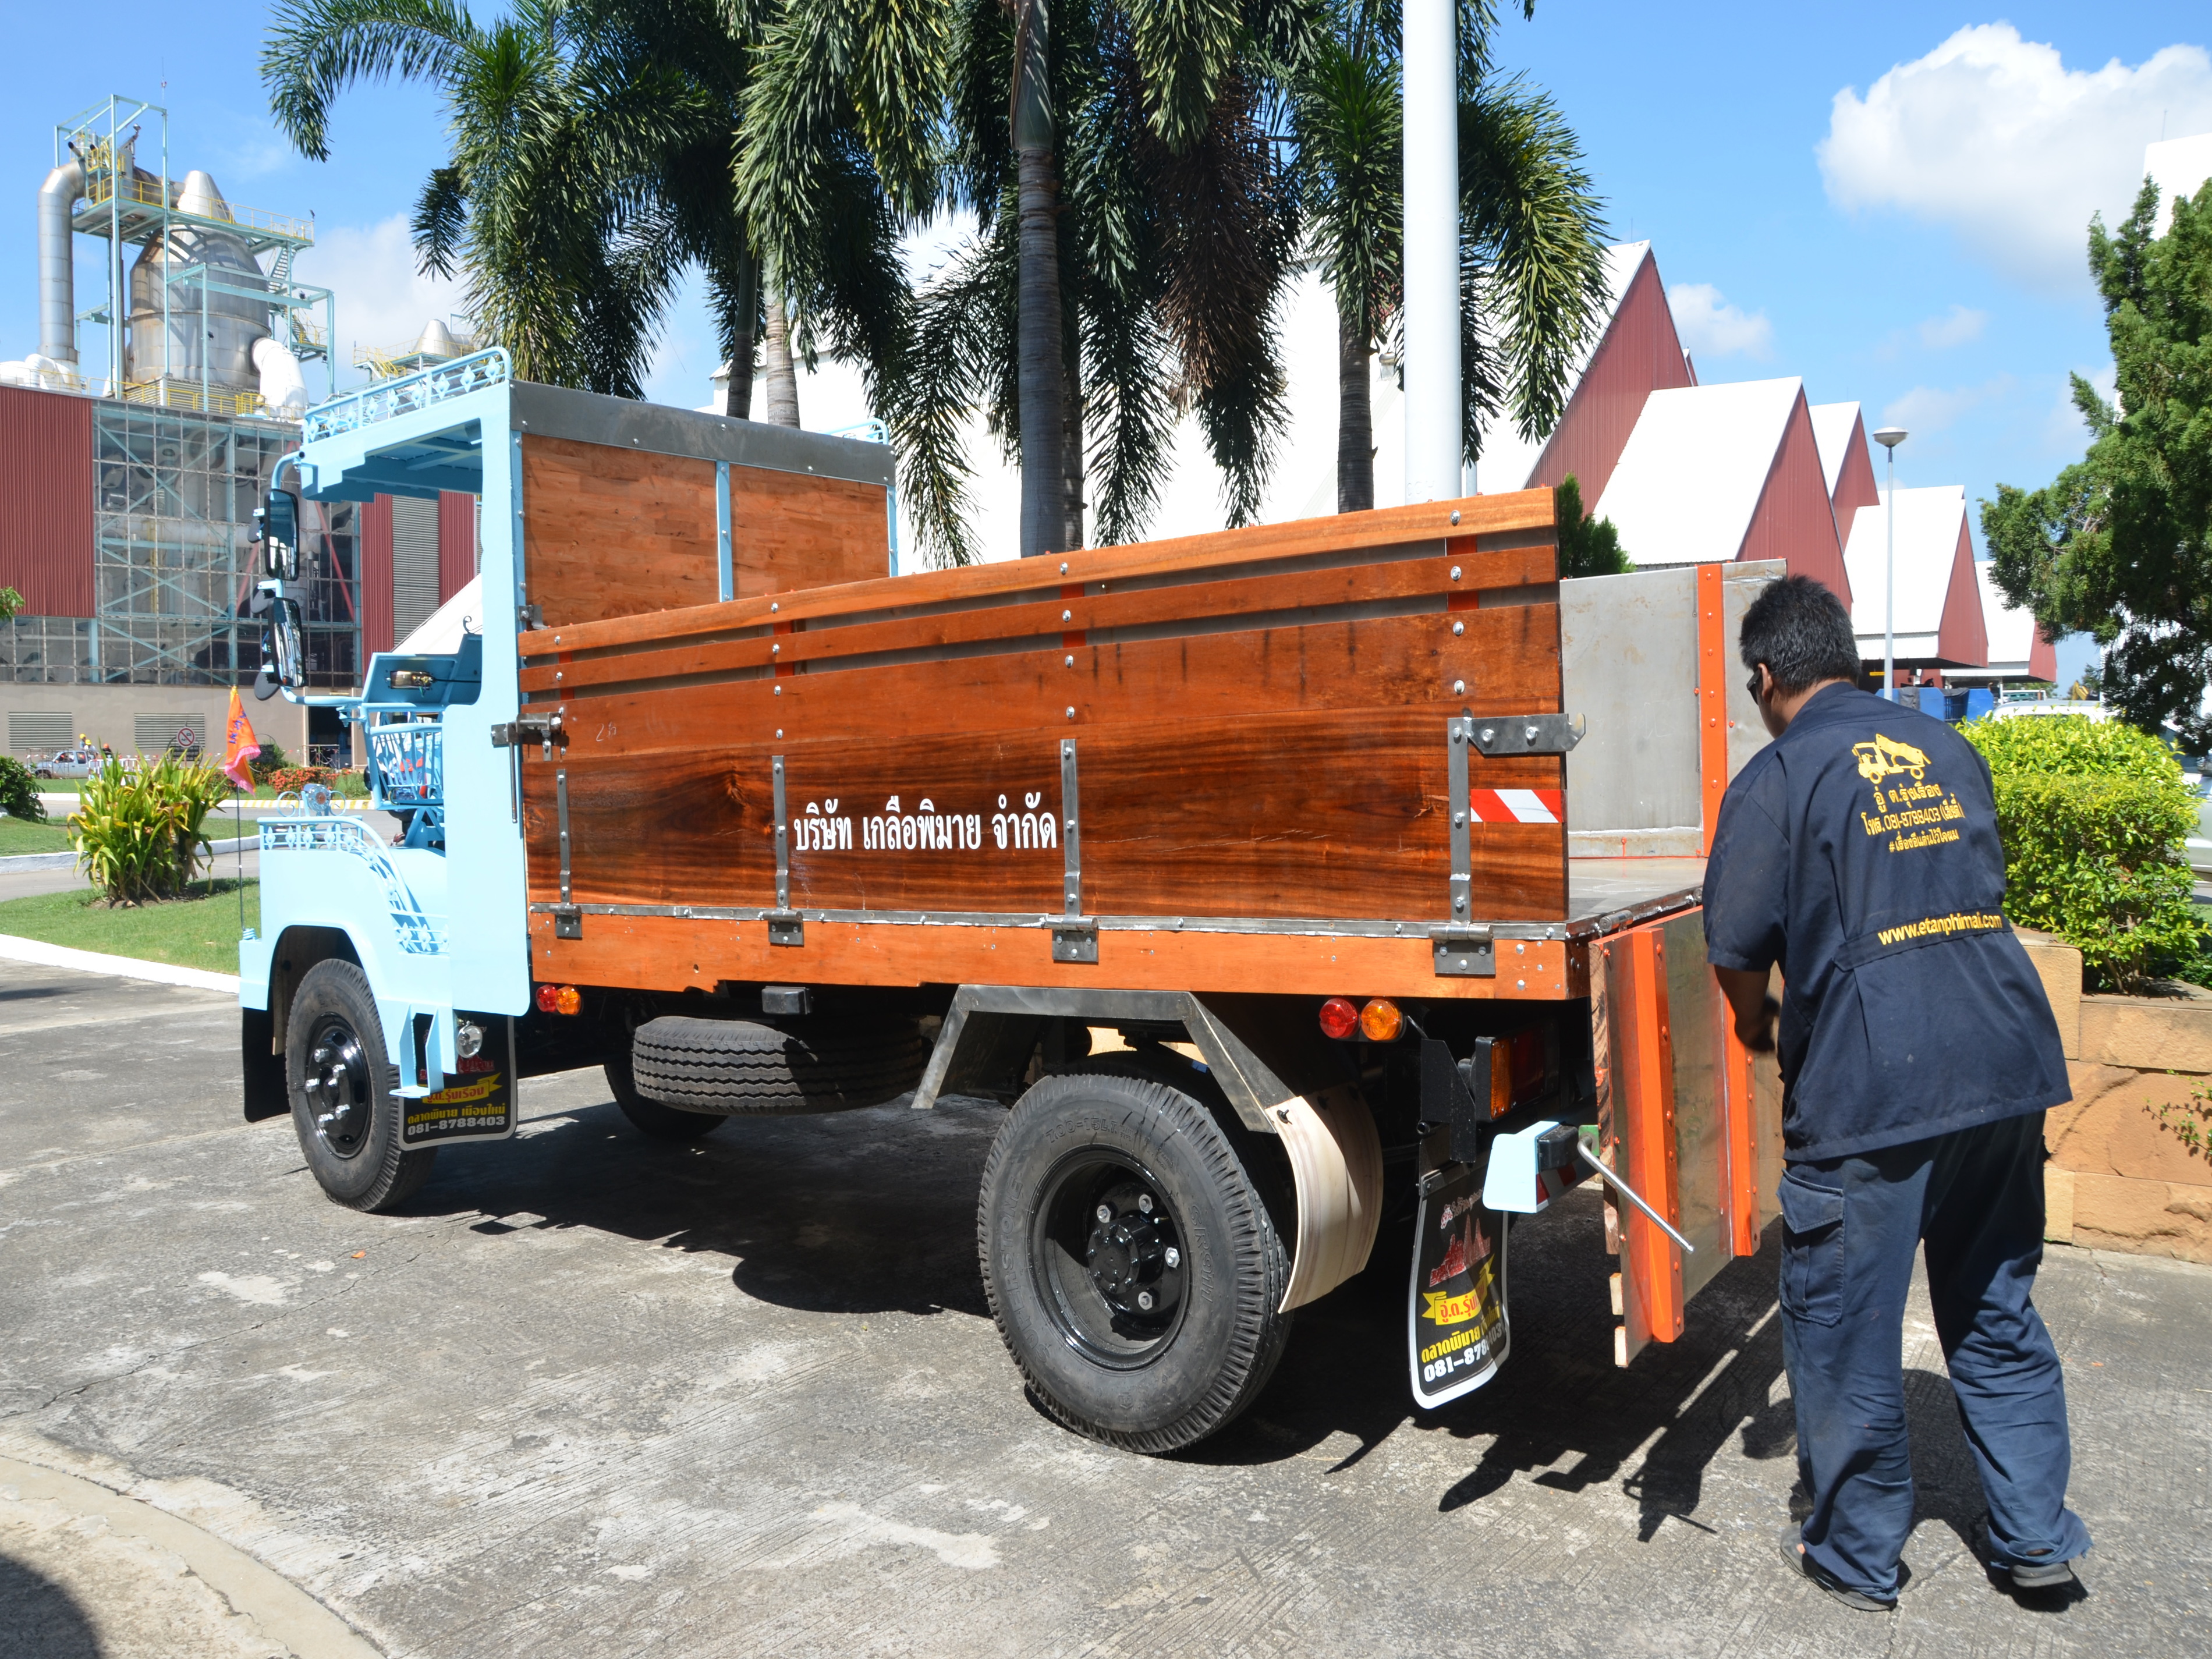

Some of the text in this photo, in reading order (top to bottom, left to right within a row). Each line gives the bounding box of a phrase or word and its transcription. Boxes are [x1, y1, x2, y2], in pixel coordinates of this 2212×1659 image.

[1873, 786, 1888, 813] อู่
[794, 792, 1057, 850] บริษัท เกลือพิมาย จำกัด
[1878, 912, 2003, 946] www.etanphimai.com
[407, 1103, 506, 1125] ตลาดพิมาย เมืองใหม่
[407, 1116, 505, 1136] 081-8788403
[999, 1175, 1051, 1364] SUPERSTONE
[1421, 1325, 1481, 1363] ตลาดพิมาย
